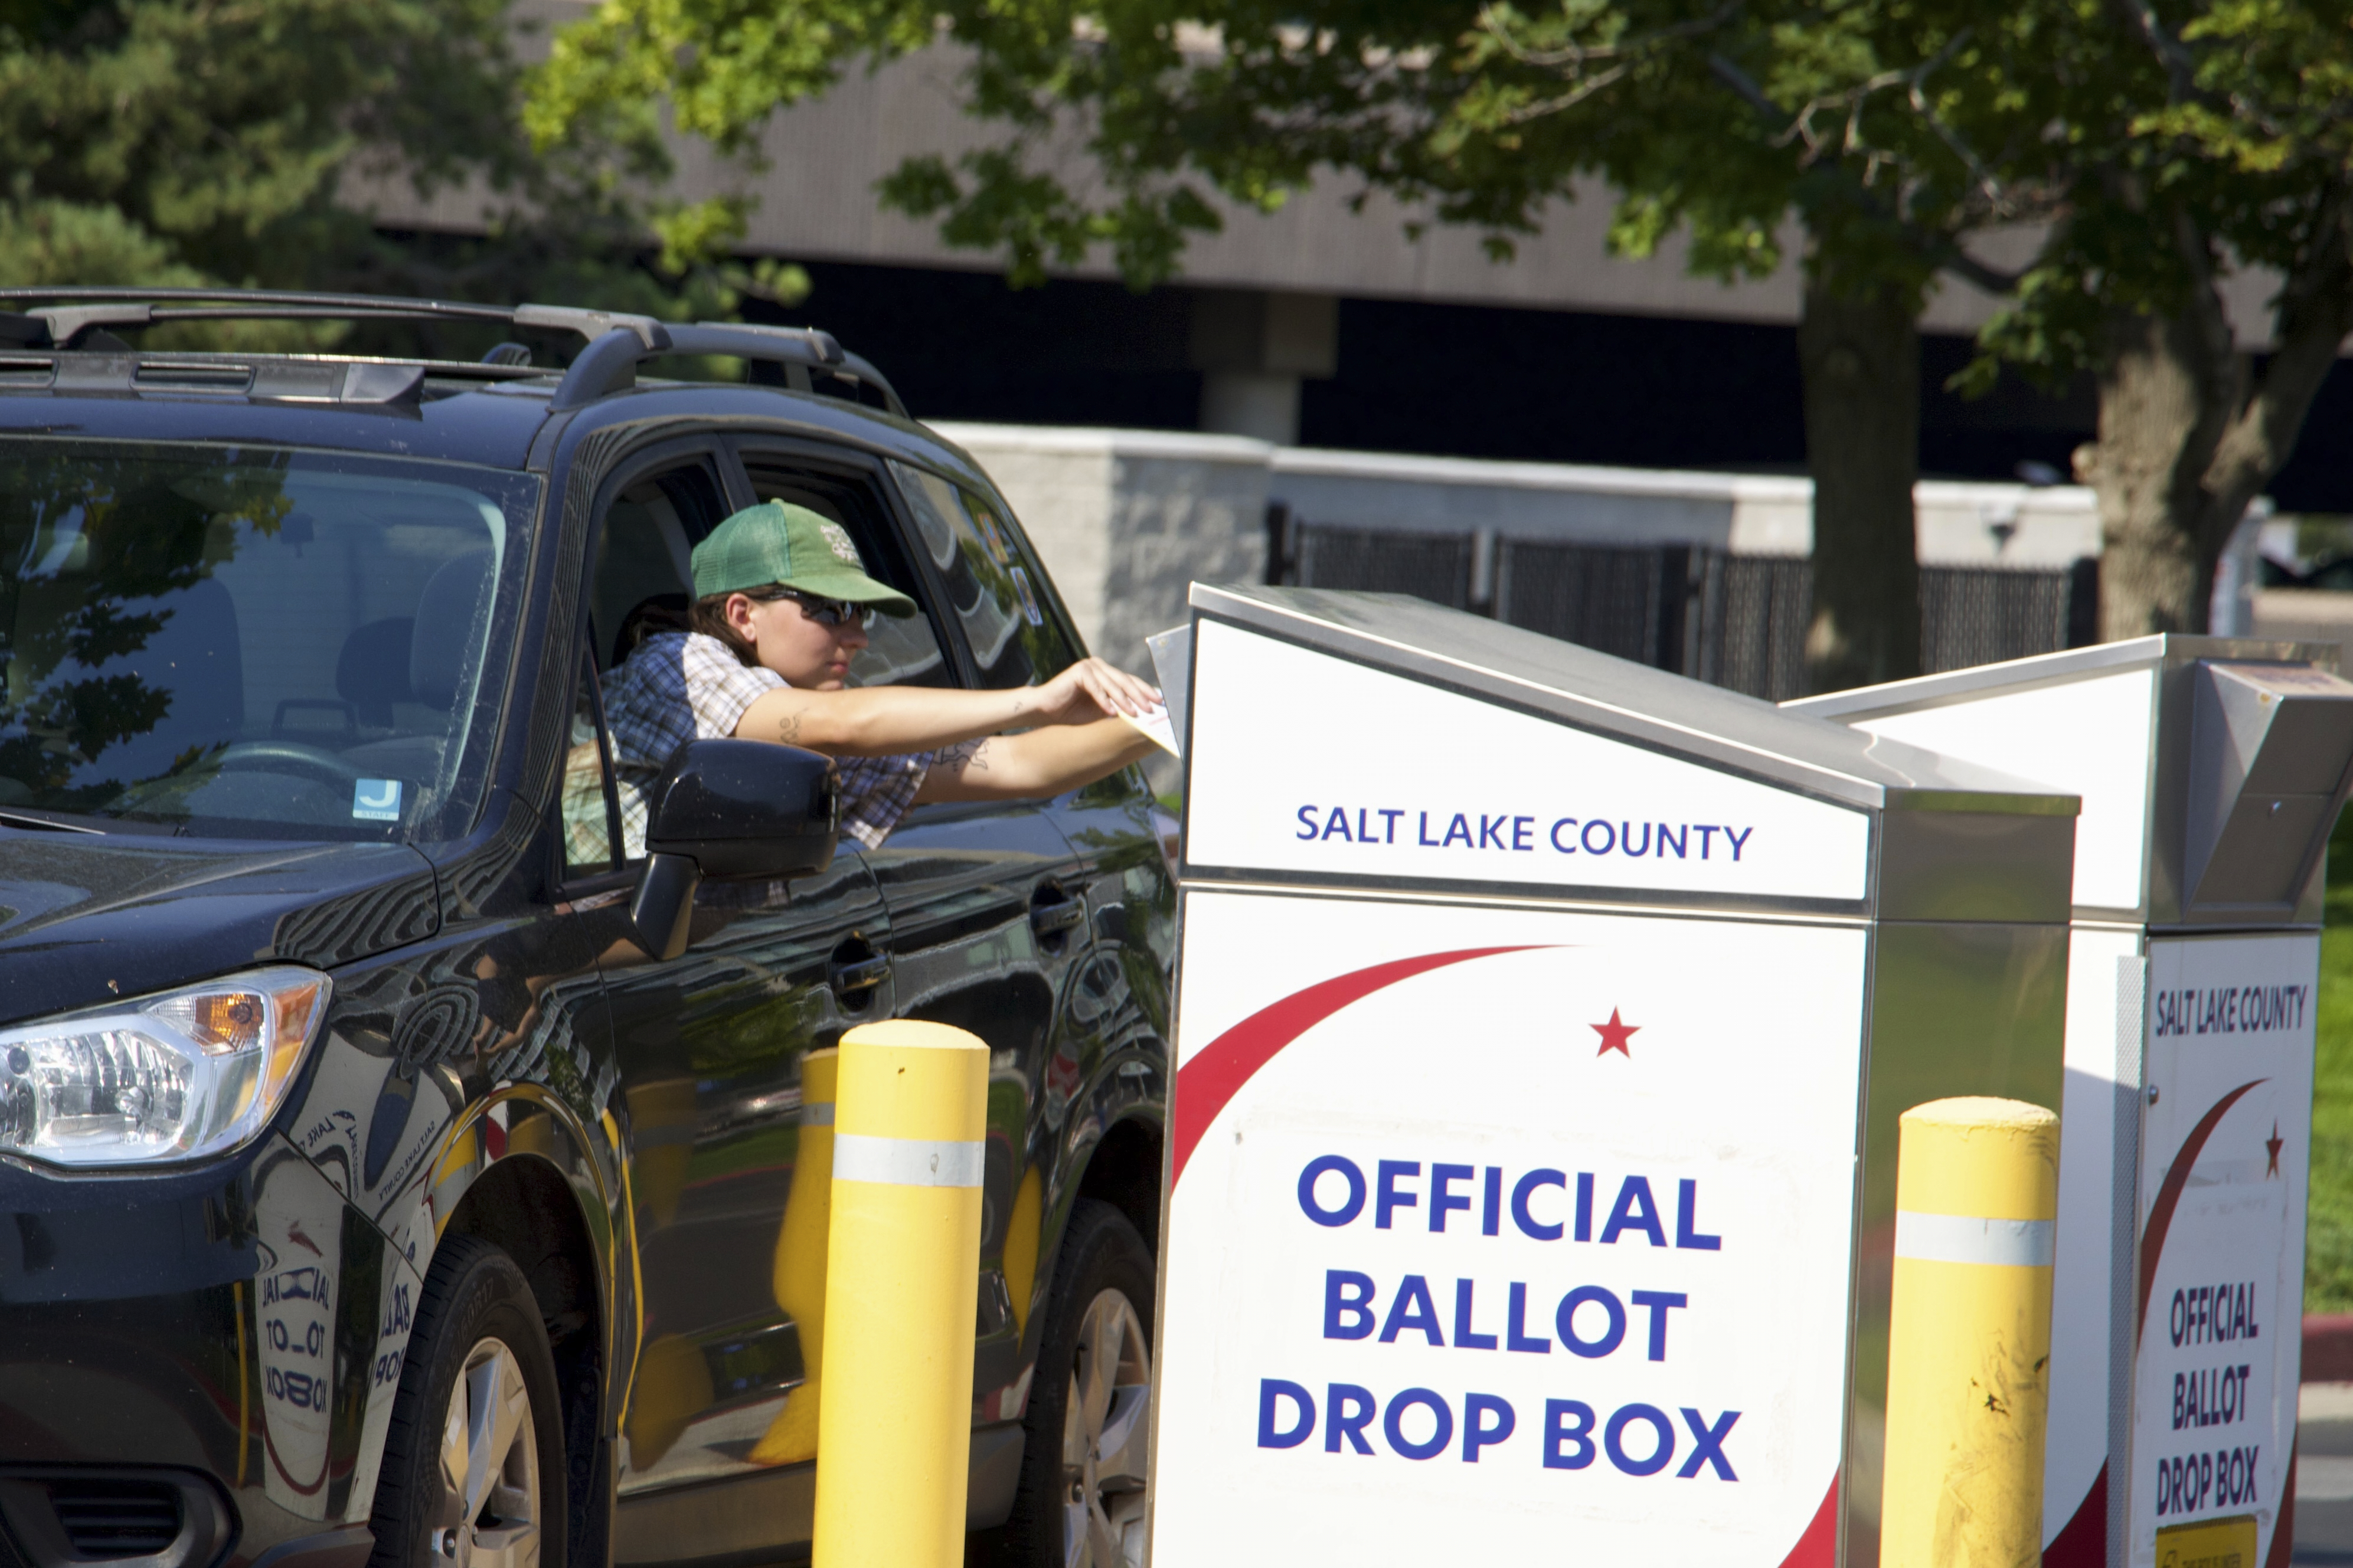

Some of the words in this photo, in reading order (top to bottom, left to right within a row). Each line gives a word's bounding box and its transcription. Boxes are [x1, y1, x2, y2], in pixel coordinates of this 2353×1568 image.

[1296, 806, 1404, 843] SALT
[1419, 811, 1534, 851] LAKE
[1550, 818, 1753, 862] COUNTY
[2156, 989, 2195, 1037] SALT
[2196, 987, 2238, 1035] LAKE
[2240, 984, 2308, 1032] COUNTY
[1297, 1154, 1721, 1251] OFFICIAL
[1323, 1269, 1688, 1362] BALLOT
[2170, 1281, 2260, 1348] OFFICIAL
[1257, 1379, 1515, 1464] DROP
[1542, 1398, 1741, 1482] BOX
[2172, 1364, 2250, 1431] BALLOT
[2156, 1452, 2213, 1517] DROP
[2215, 1445, 2260, 1508] BOX
